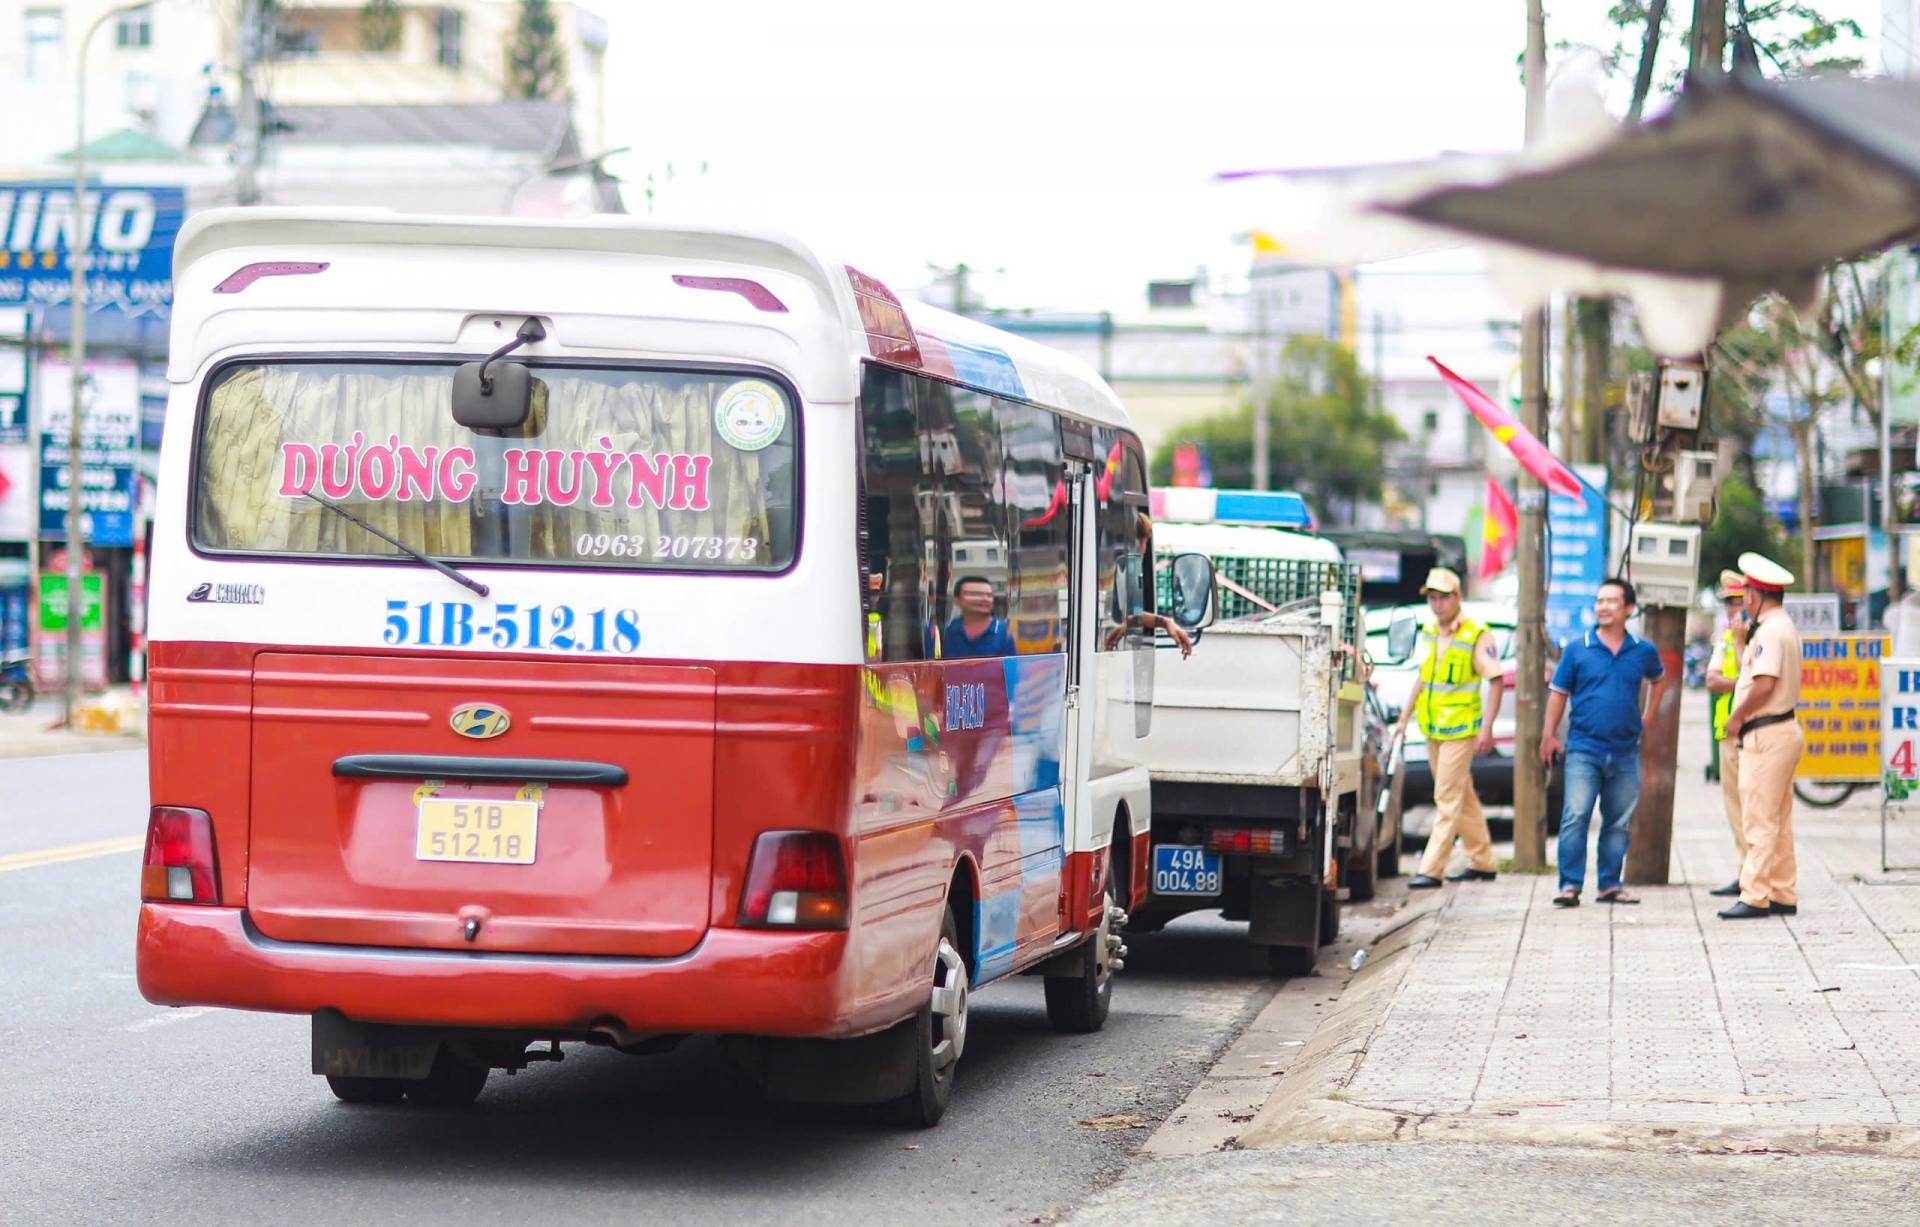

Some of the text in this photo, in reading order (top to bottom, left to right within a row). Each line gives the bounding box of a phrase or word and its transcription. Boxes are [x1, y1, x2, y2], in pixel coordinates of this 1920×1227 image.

[279, 430, 713, 511] DƯƠNG HUỲNH
[576, 533, 759, 560] 0963 207373
[383, 598, 642, 655] 51B-512.18
[453, 804, 503, 830] 51B
[431, 832, 522, 859] 512.18
[1170, 850, 1205, 871] 49A
[1157, 871, 1218, 891] 004.88
